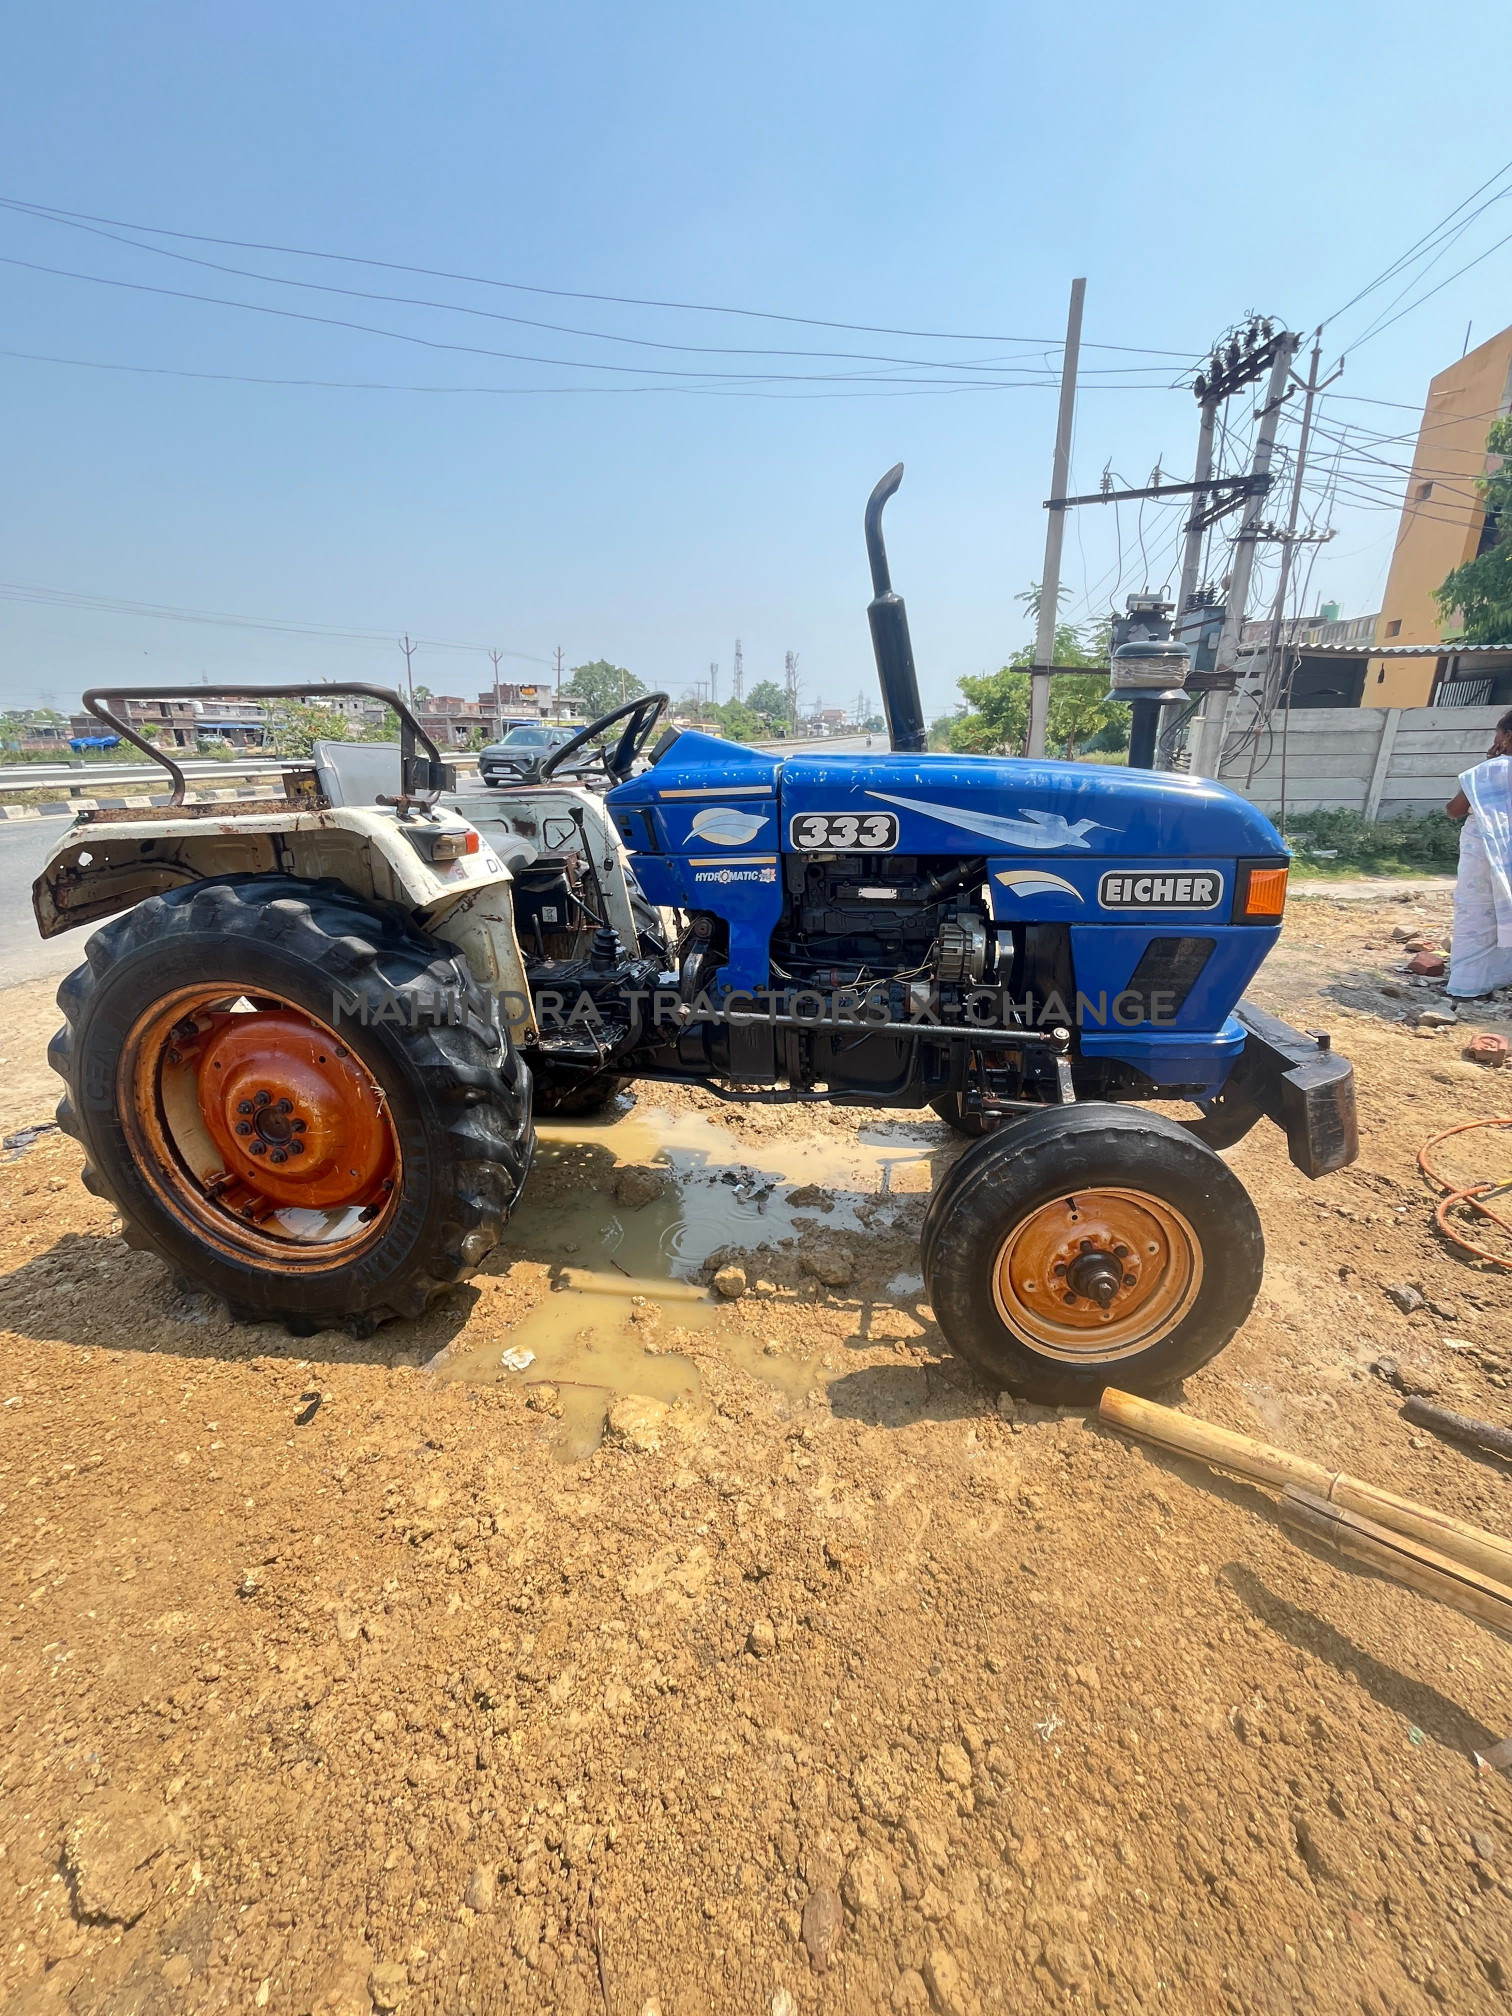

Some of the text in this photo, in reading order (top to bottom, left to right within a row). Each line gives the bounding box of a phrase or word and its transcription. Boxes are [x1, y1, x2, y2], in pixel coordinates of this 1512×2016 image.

[799, 816, 891, 847] 333
[695, 870, 759, 882] HYDROMATIC
[1106, 878, 1213, 902] EICHER
